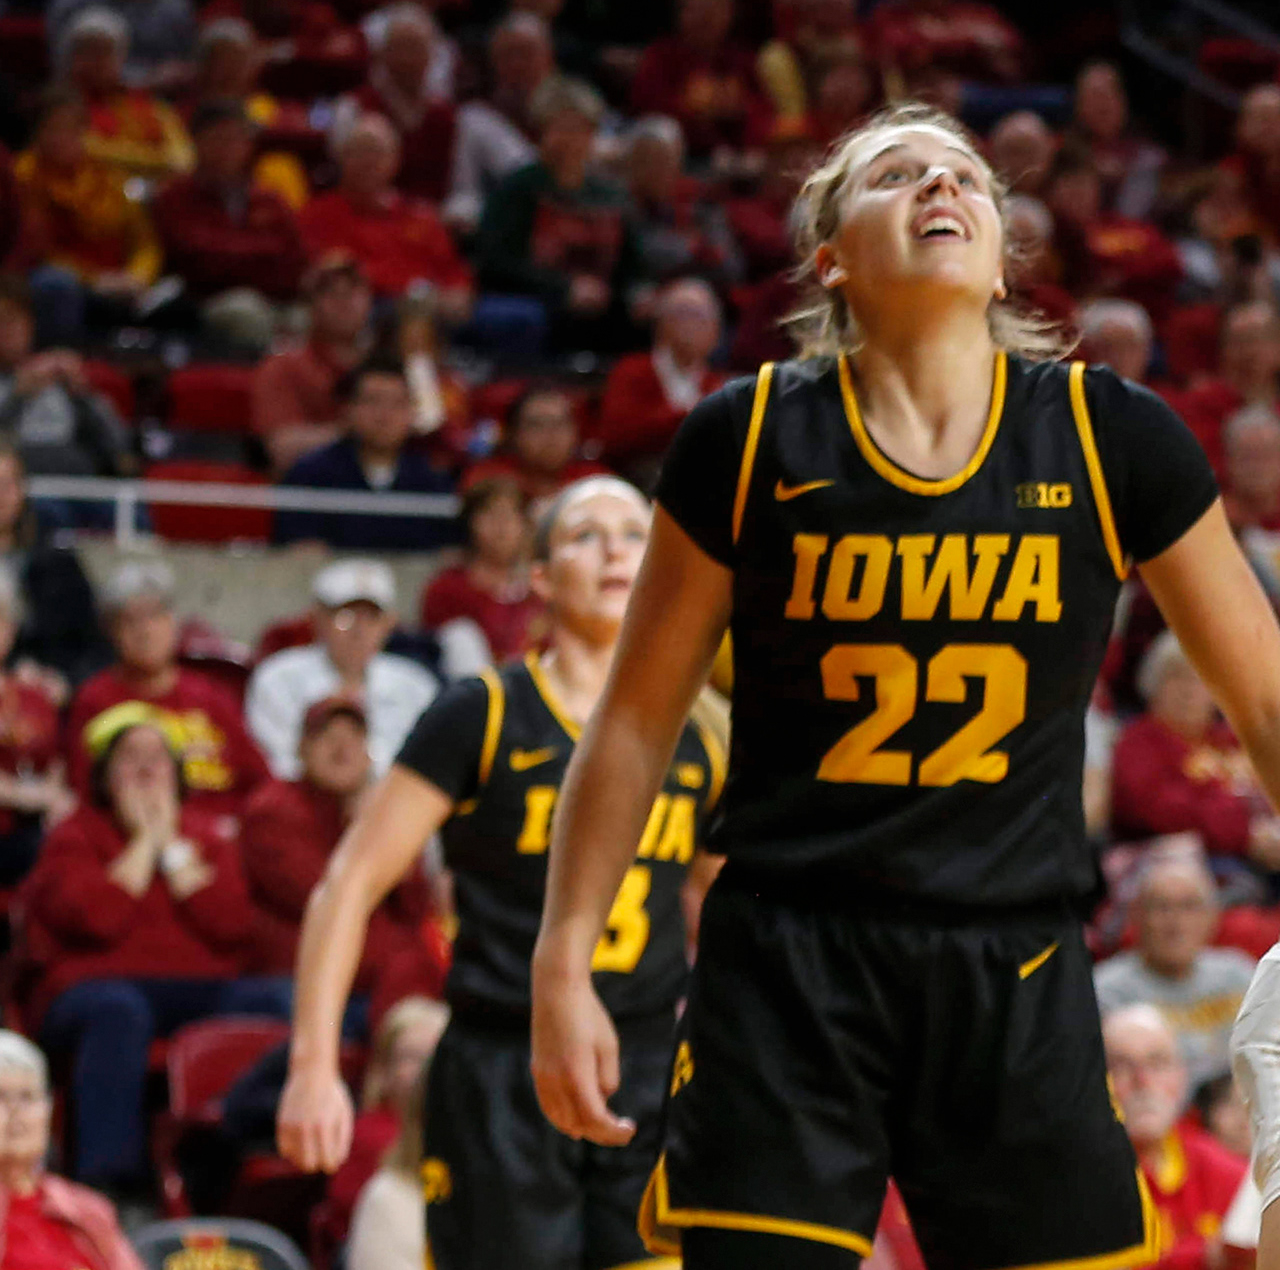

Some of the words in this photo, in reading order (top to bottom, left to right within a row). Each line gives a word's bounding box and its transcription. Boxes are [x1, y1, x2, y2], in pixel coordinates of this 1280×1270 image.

[784, 534, 1063, 622] IOWA
[815, 643, 1028, 787] 22
[516, 786, 697, 865] IA
